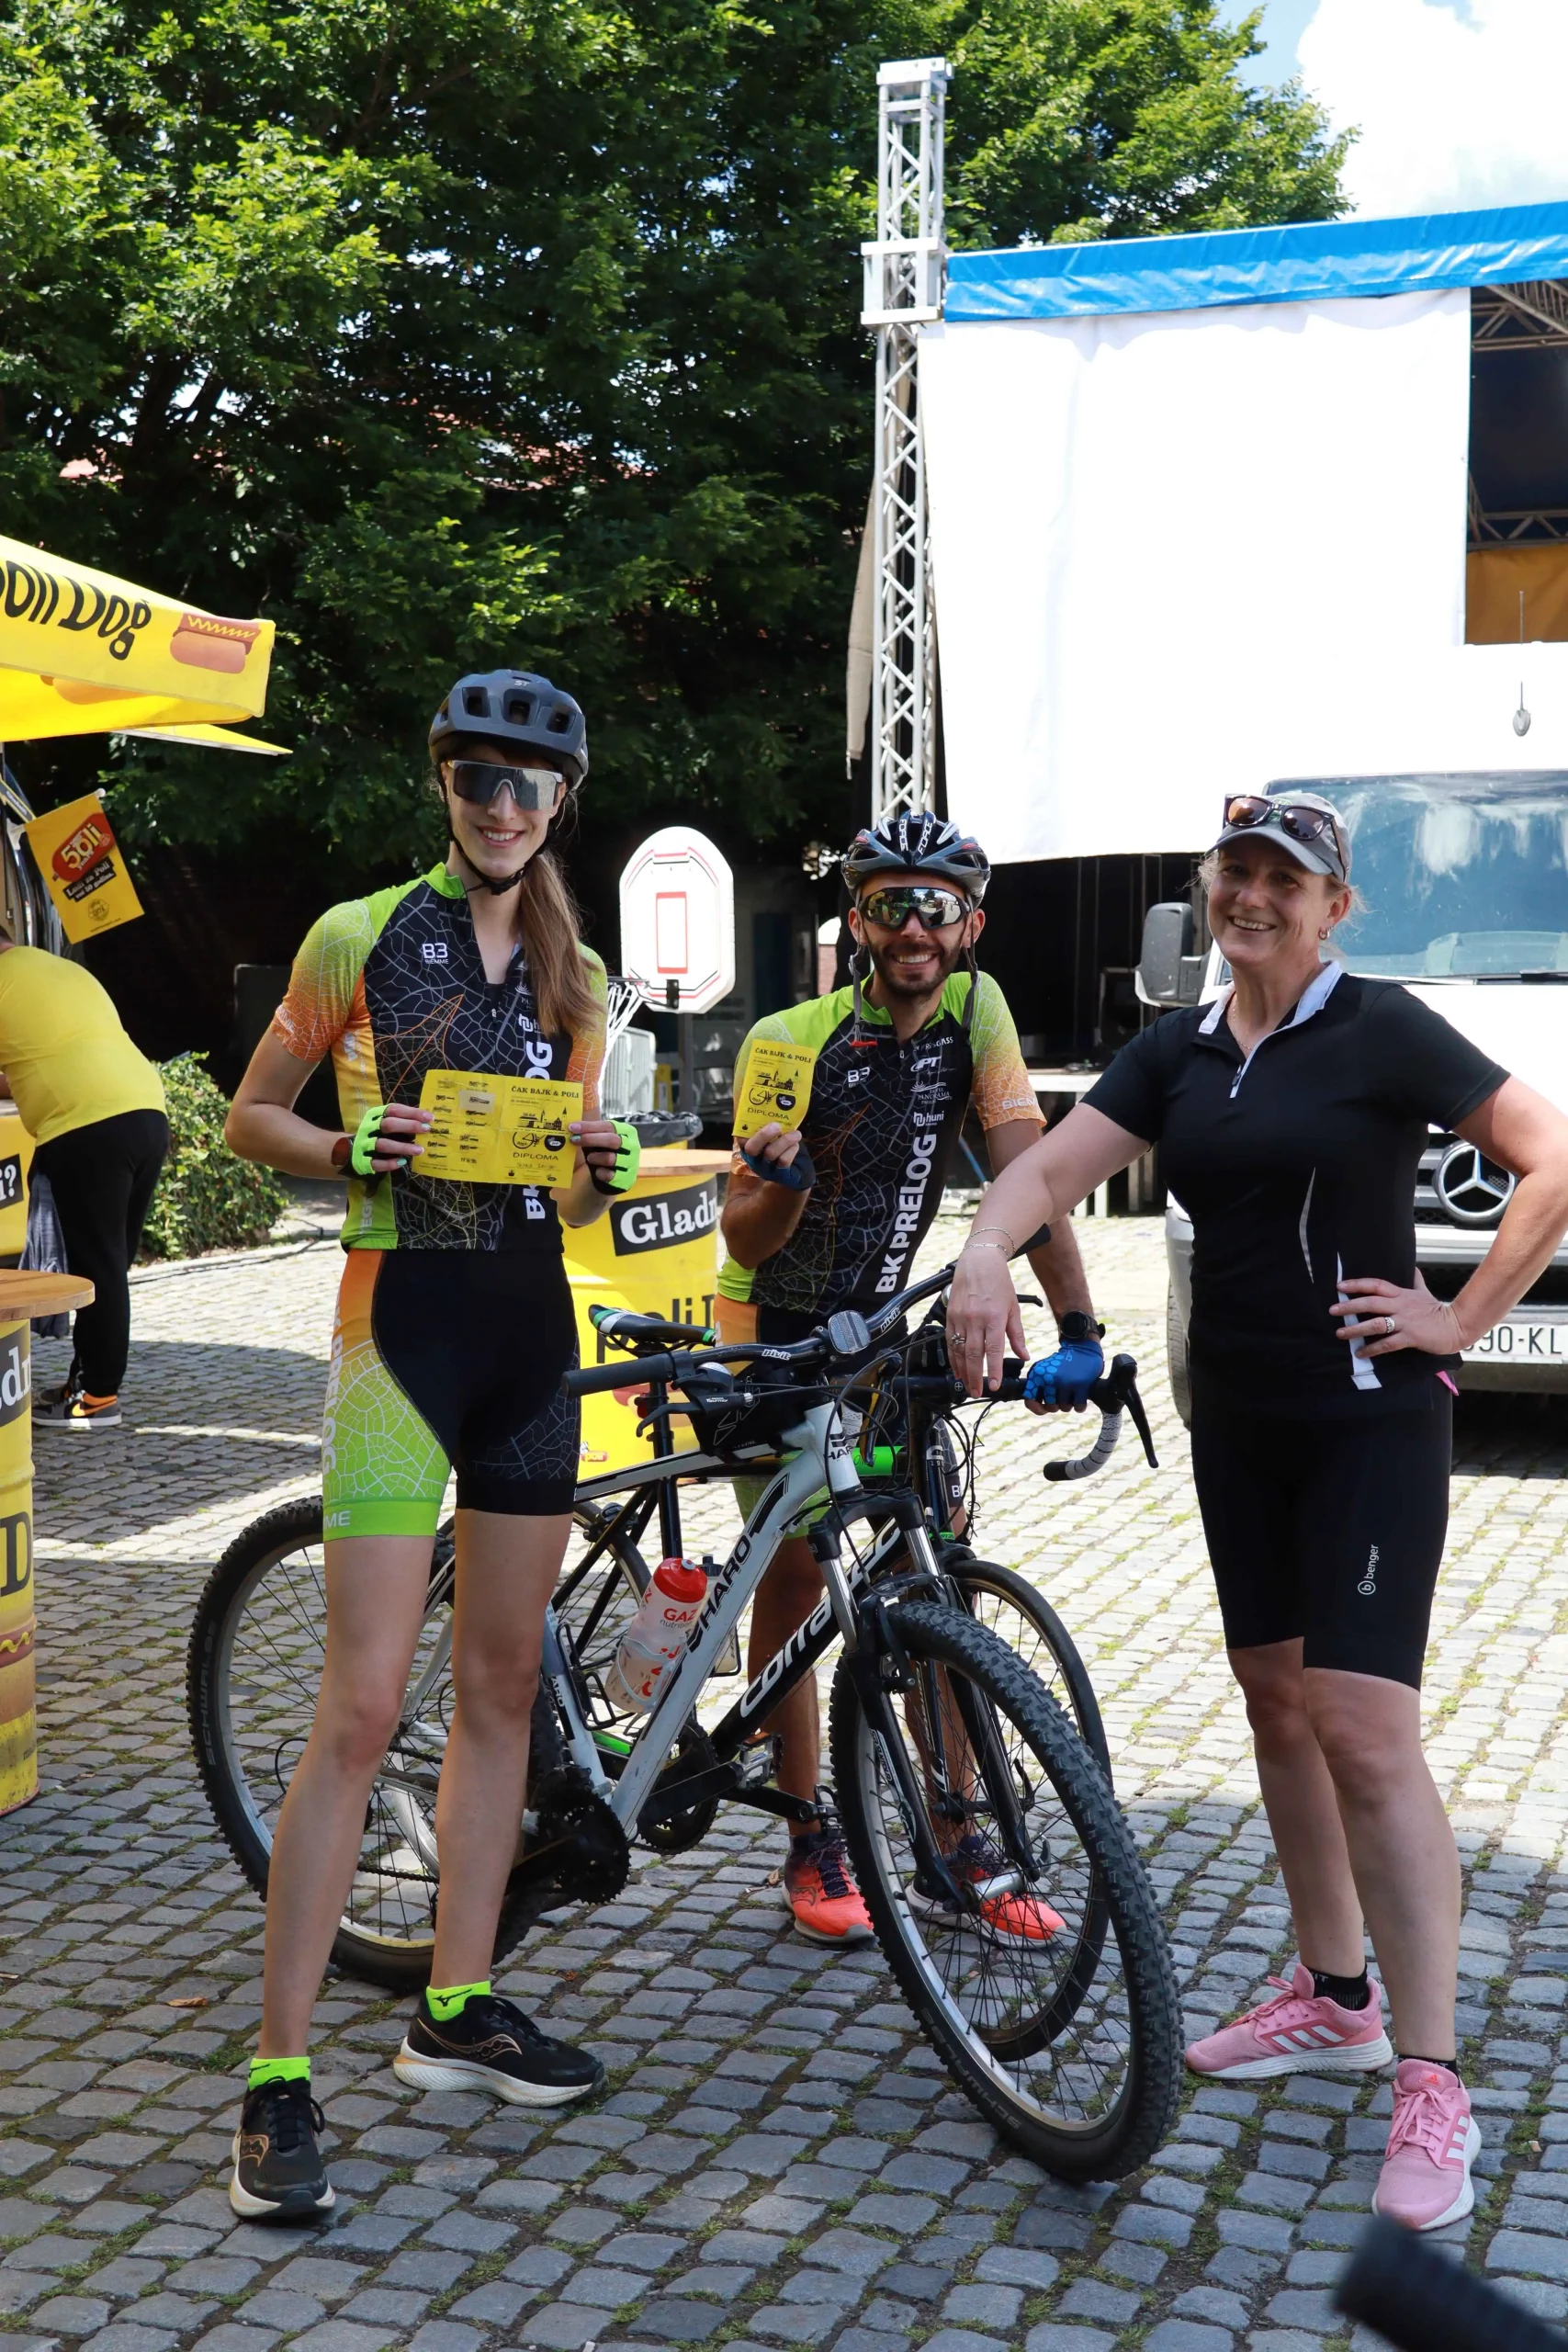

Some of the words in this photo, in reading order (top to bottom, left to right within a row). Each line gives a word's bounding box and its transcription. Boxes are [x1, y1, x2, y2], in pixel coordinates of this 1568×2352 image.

[58, 575, 152, 661] Dog
[899, 820, 908, 852] FORCE
[918, 820, 933, 855] FORCE
[94, 861, 110, 876] Poli
[795, 1055, 811, 1063] POLI
[512, 1085, 528, 1093] ČAK
[530, 1087, 551, 1096] BAJK
[561, 1091, 580, 1099] POLI
[748, 1107, 789, 1120] DIPLOMA
[926, 1111, 944, 1123] huni
[513, 1152, 559, 1160] DIPLOMA
[889, 1134, 937, 1249] PRELOG
[875, 1252, 907, 1293] BK
[880, 1305, 901, 1332] pivit
[761, 1349, 791, 1361] pivit
[1363, 1544, 1380, 1579] benger
[698, 1538, 752, 1631] HARO
[199, 1621, 217, 1766] SCHWALBE
